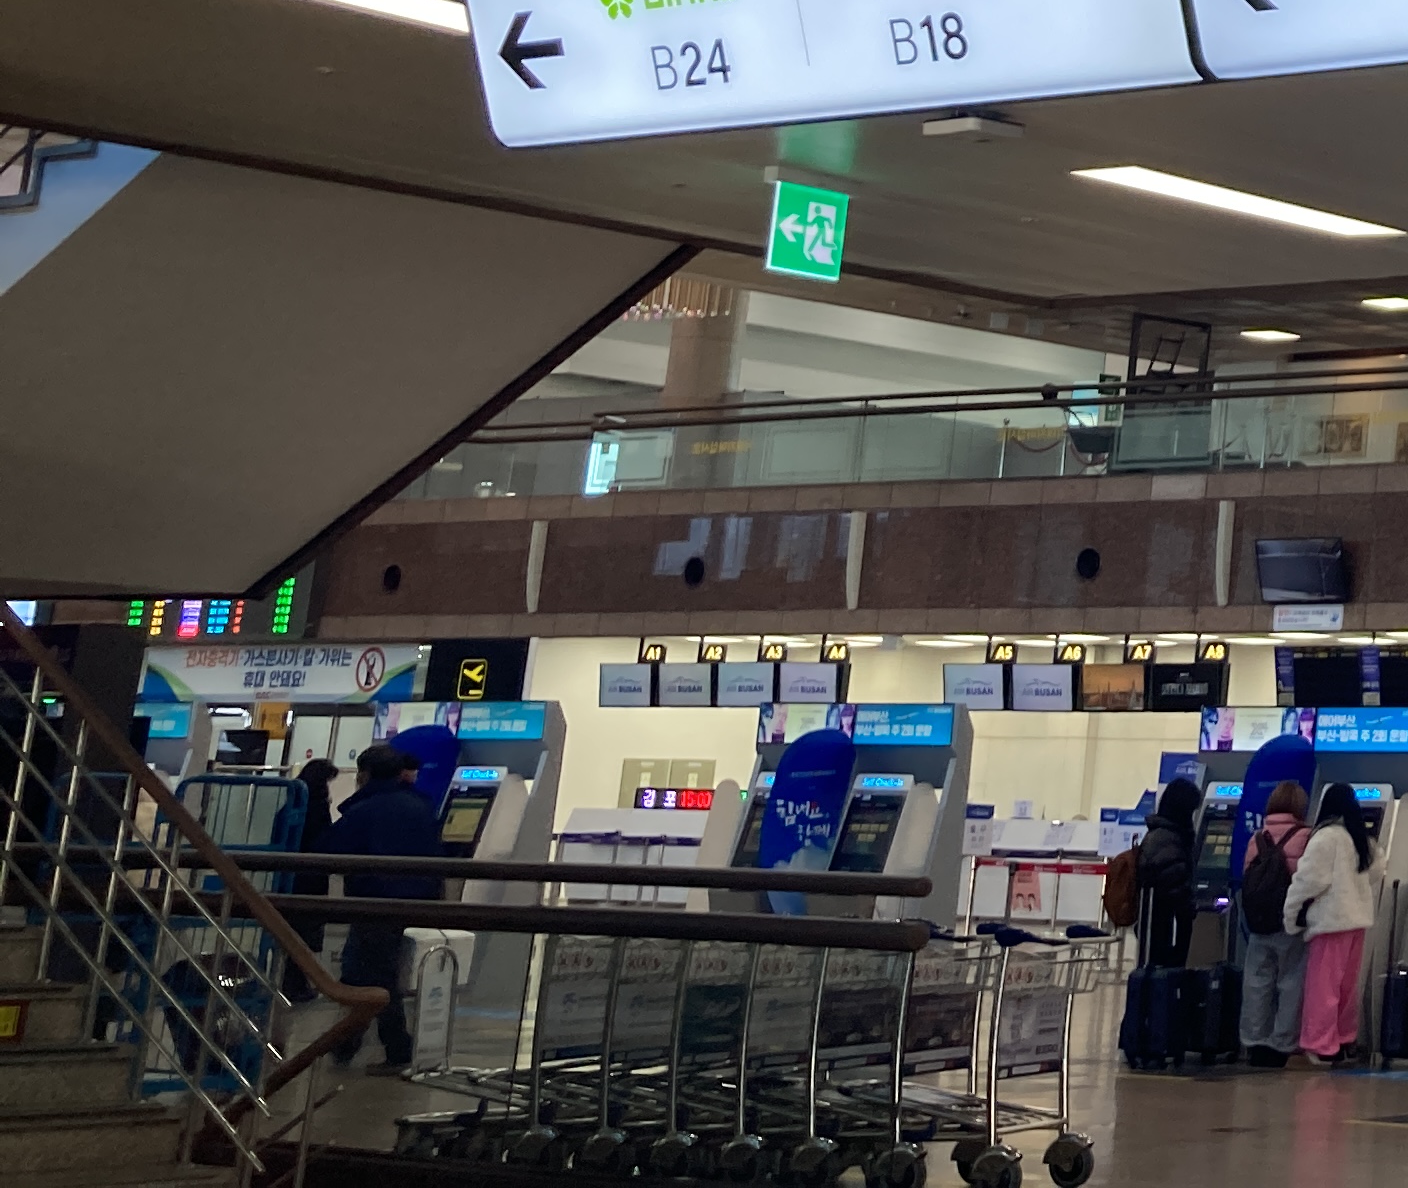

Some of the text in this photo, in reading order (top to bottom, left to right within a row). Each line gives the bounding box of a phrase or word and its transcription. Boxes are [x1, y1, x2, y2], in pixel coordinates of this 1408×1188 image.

[888, 12, 969, 67] B18
[650, 39, 732, 91] B24
[644, 647, 661, 661] A1
[704, 646, 723, 660] A2
[766, 646, 783, 659] A3
[828, 645, 847, 659] A4
[994, 646, 1013, 660] A5
[1063, 646, 1082, 660] A6
[1133, 645, 1152, 660] A7
[1205, 644, 1224, 659] A8
